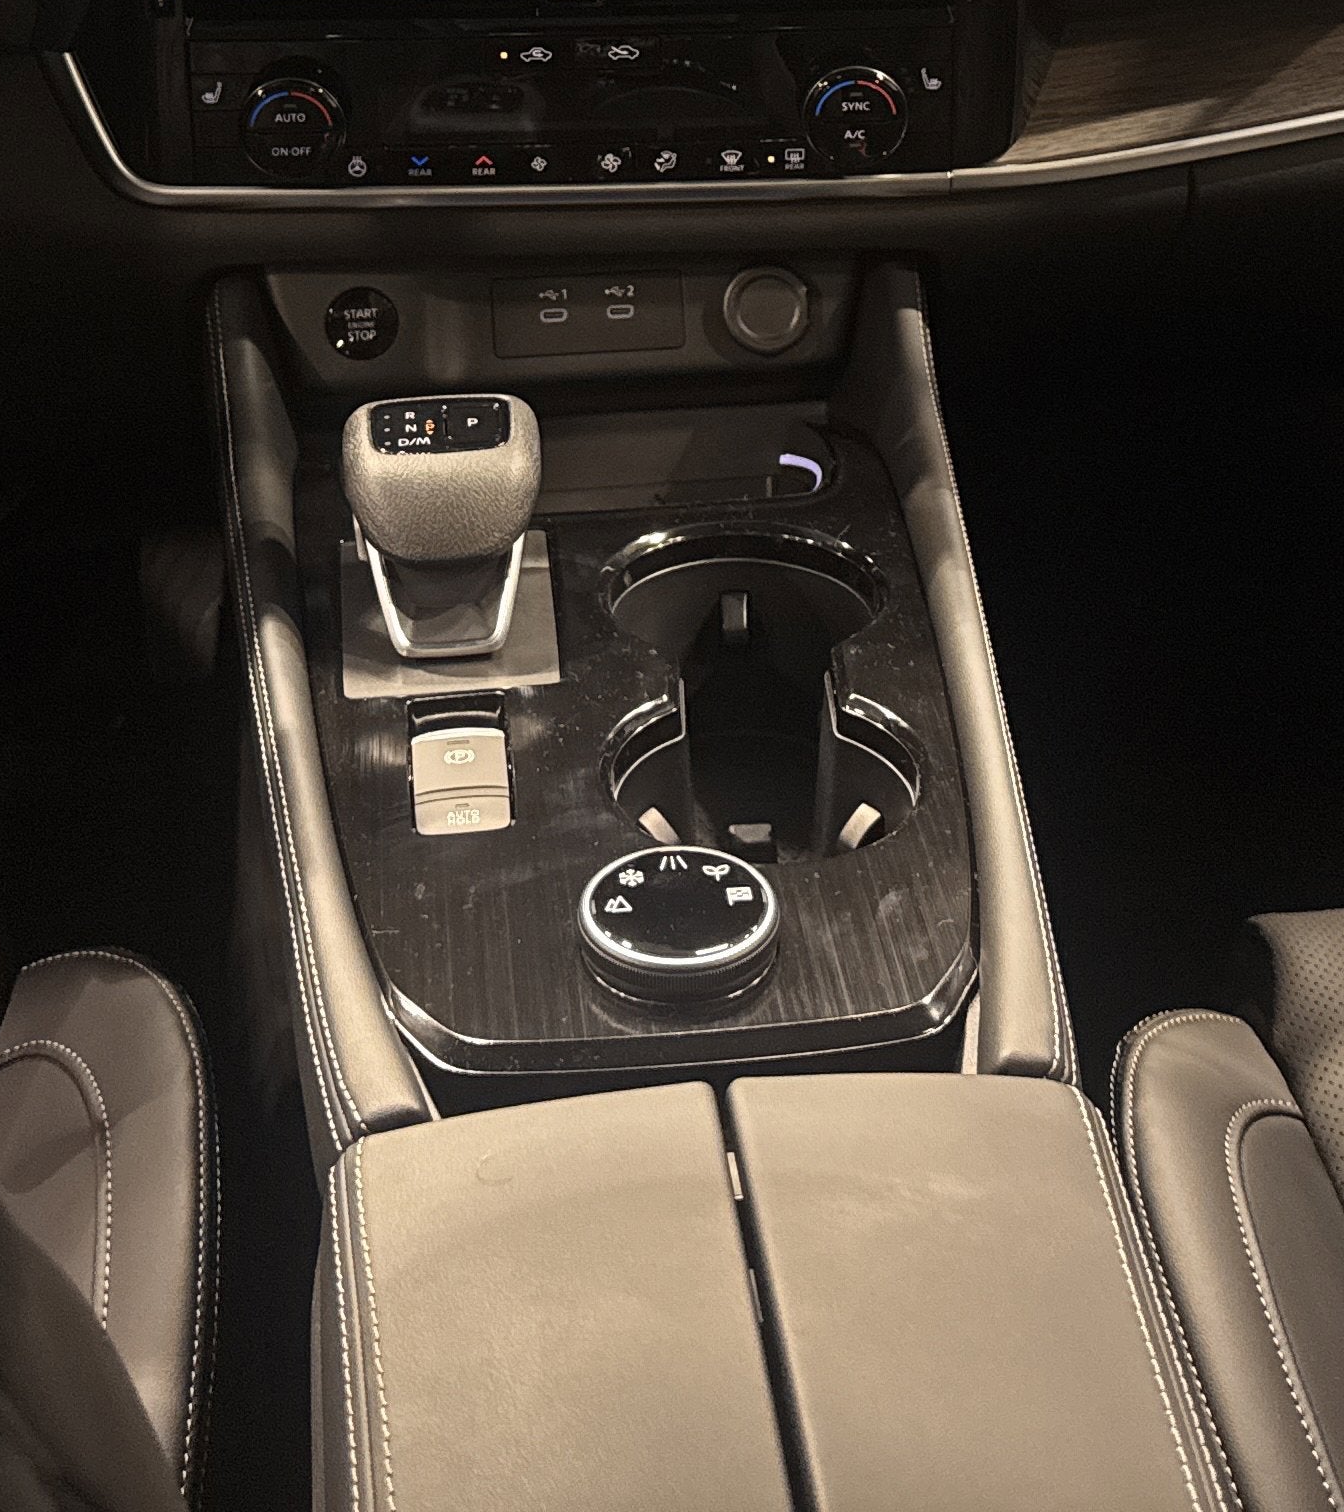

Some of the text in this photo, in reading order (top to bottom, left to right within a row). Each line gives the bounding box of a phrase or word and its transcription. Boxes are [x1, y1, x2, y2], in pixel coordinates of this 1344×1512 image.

[841, 101, 871, 112] SYNC
[274, 112, 306, 123] AUTO
[843, 129, 866, 139] A/C
[408, 168, 433, 176] REAR
[471, 168, 496, 176] REAR
[784, 163, 805, 171] REAR
[626, 285, 635, 297] 2
[343, 307, 379, 320] START
[347, 330, 377, 342] STOP
[404, 411, 415, 420] R
[467, 417, 478, 427] P
[405, 424, 417, 433] N
[397, 436, 431, 447] D/M
